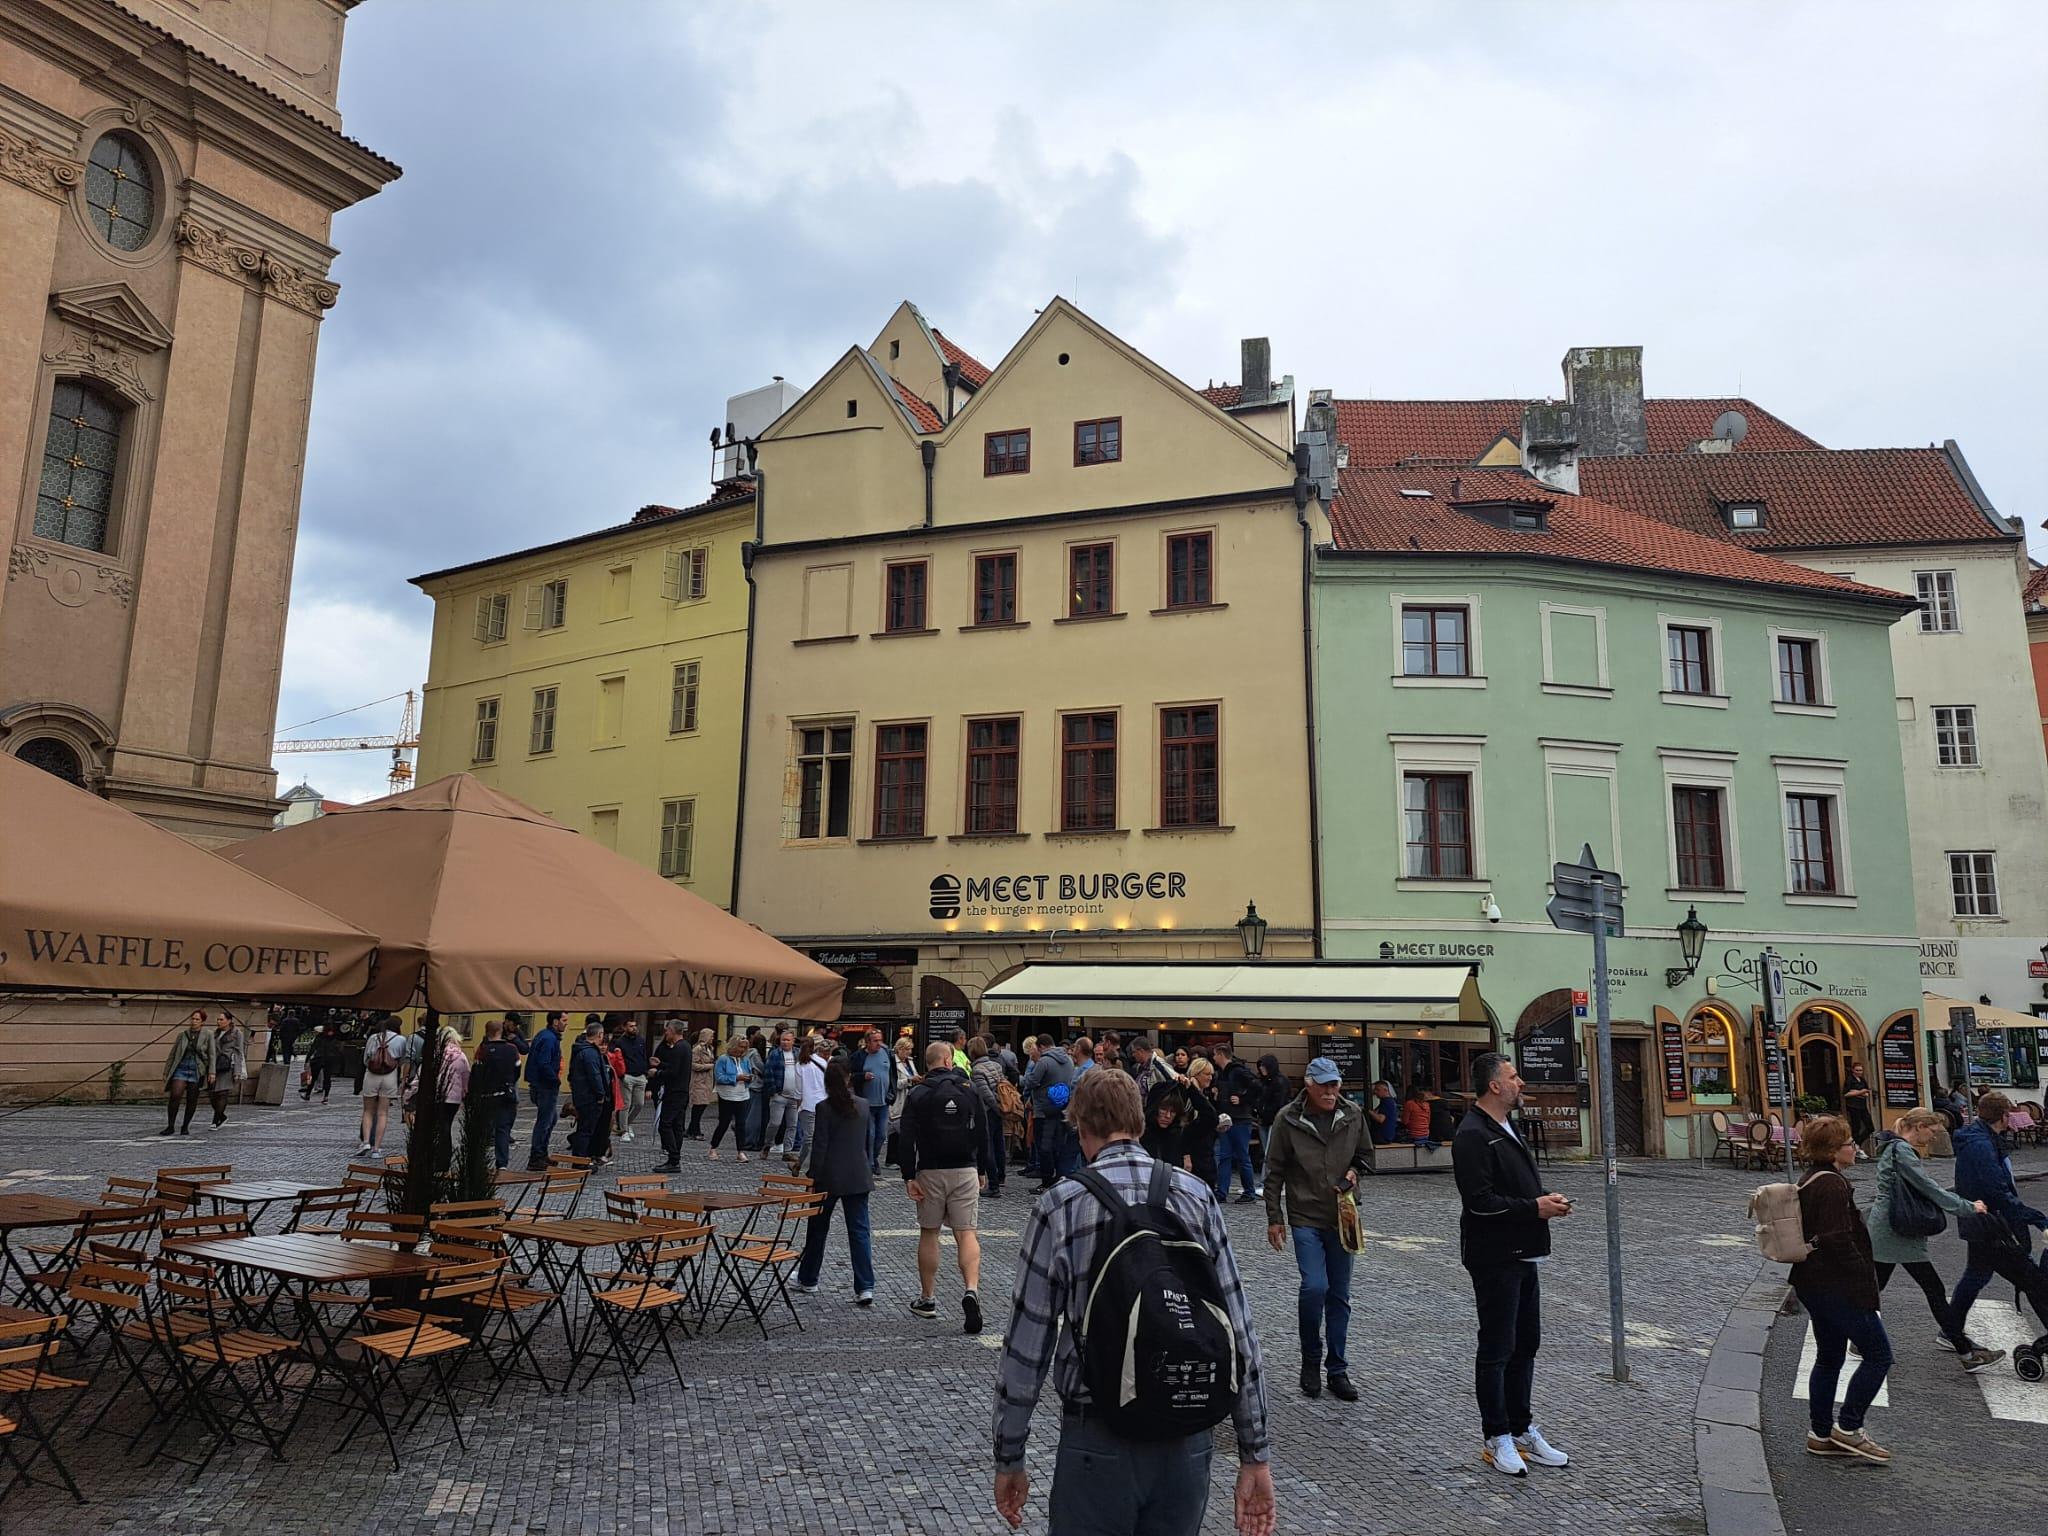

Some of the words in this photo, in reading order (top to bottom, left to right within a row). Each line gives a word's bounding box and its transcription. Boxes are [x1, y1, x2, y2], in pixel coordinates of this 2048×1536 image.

[966, 874, 1049, 903] MEET
[1058, 872, 1187, 901] BURGER
[966, 904, 987, 917] the
[990, 904, 1034, 918] burger
[1036, 902, 1104, 917] meetpoint
[24, 928, 191, 976] WAFFLE,
[204, 942, 332, 977] COFFEE
[1396, 943, 1435, 955] MEET
[1439, 944, 1494, 956] BURGER
[1593, 967, 1649, 977] PODÁŘSKÁ
[513, 964, 631, 998] GELATO
[637, 968, 671, 998] AL
[677, 970, 797, 1008] NATURALE
[1829, 984, 1867, 997] Pizzeria
[1014, 1003, 1045, 1014] BURGER
[1523, 1106, 1542, 1116] WE
[1547, 1106, 1578, 1116] LOVE
[1523, 1120, 1579, 1130] RGERS
